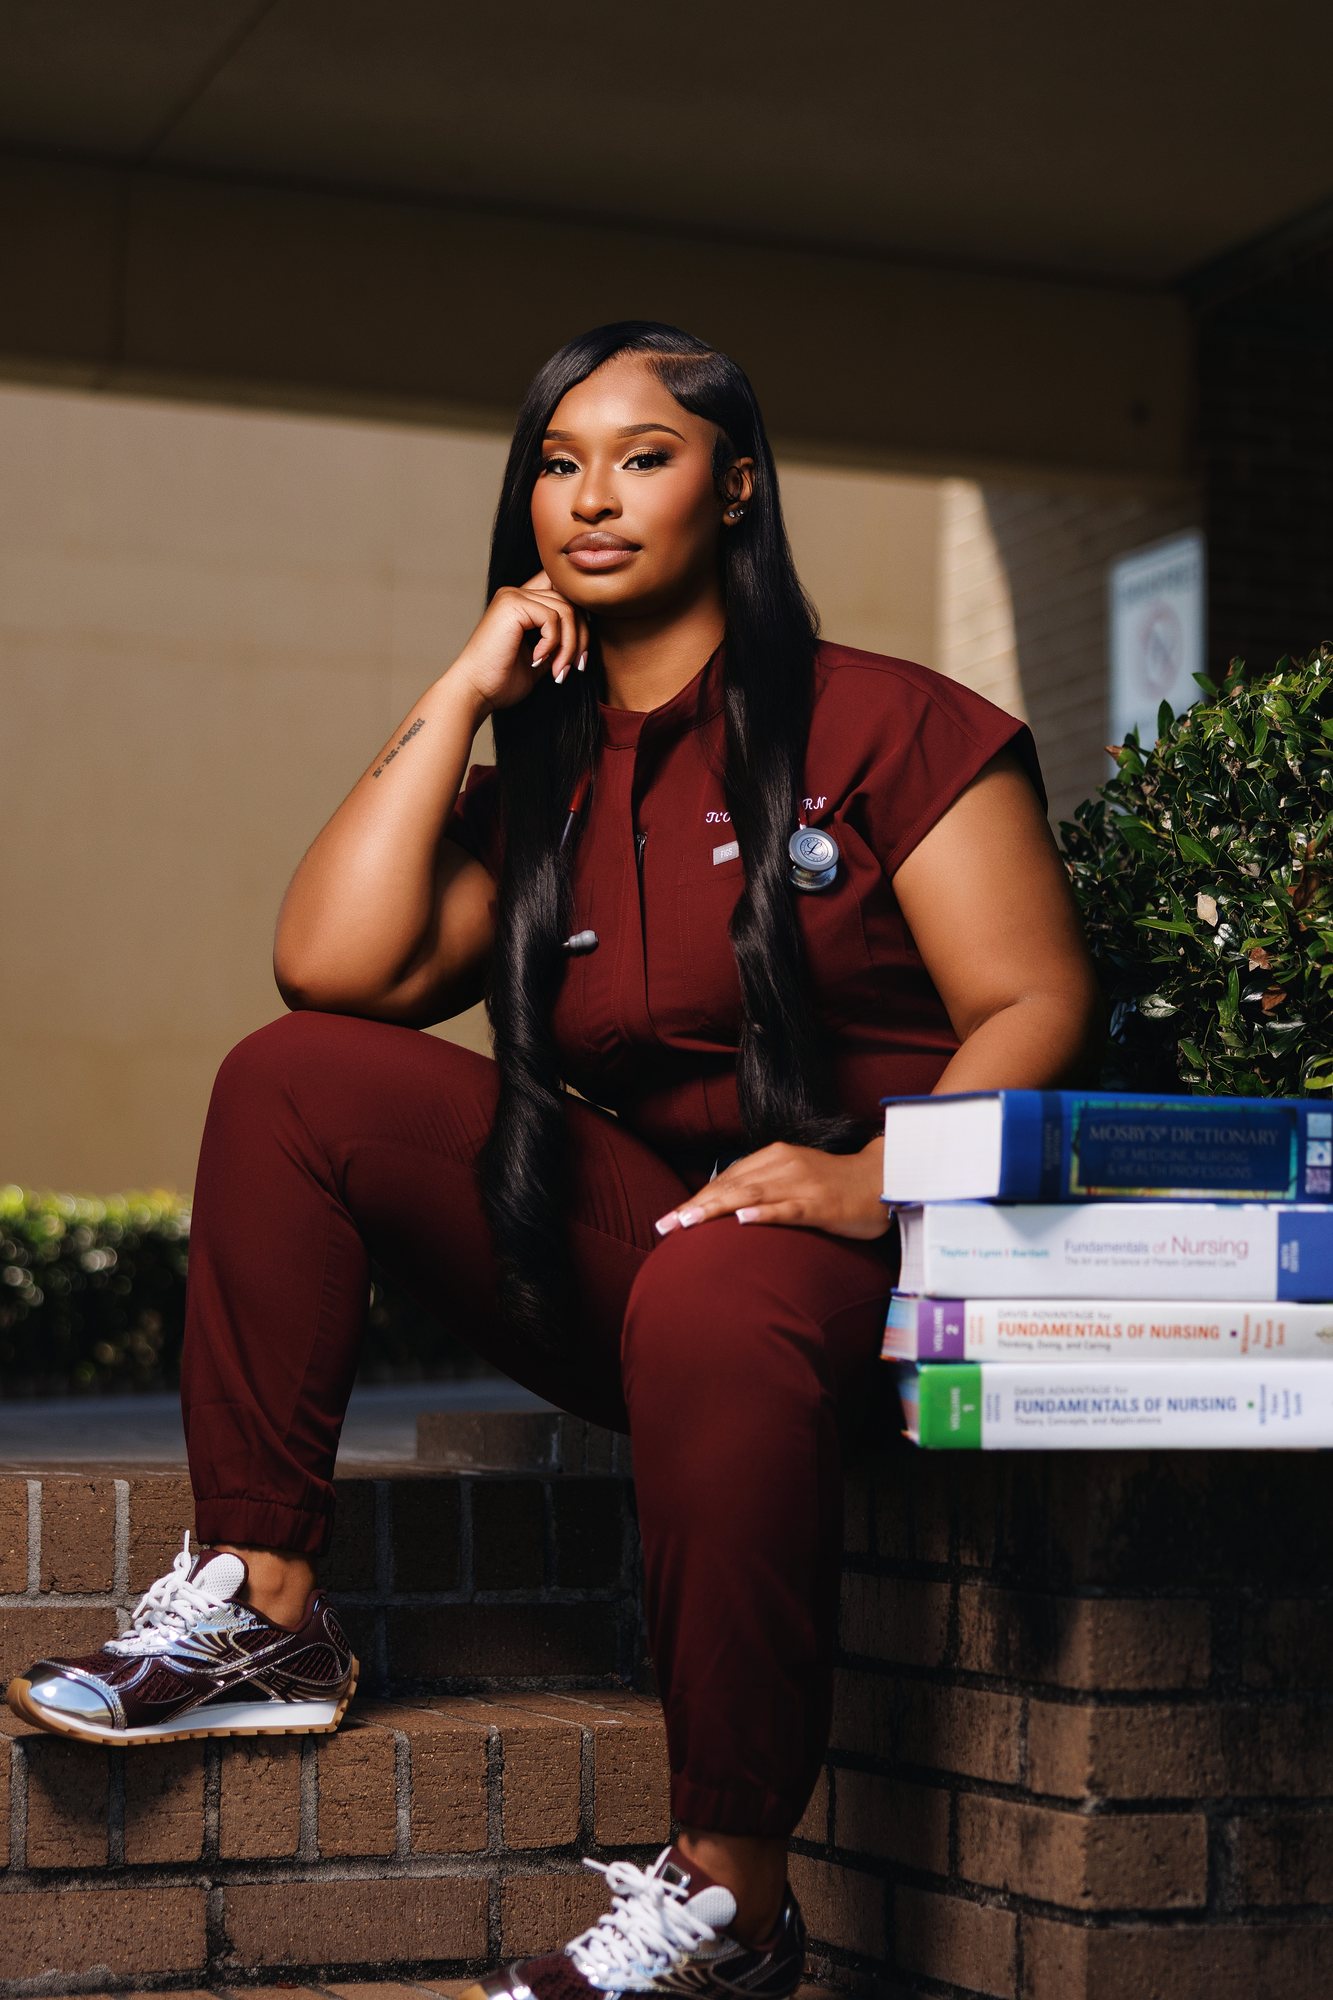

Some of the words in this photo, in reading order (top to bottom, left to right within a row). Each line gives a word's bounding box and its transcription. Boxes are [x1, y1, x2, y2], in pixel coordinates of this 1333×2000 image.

[802, 796, 827, 810] RN
[720, 847, 733, 859] FIGS
[1171, 1126, 1279, 1146] DICTIONARY
[1111, 1147, 1127, 1160] OF
[1195, 1148, 1249, 1164] NURSING
[1118, 1164, 1166, 1178] HEALTH
[1169, 1165, 1252, 1180] PROFESSIONS
[1064, 1239, 1149, 1254] Fundamentals
[1152, 1241, 1167, 1254] of
[1172, 1235, 1248, 1261] Nursing
[998, 1309, 1028, 1320] DAVIS
[1032, 1309, 1094, 1320] ADVANTAGE
[945, 1324, 959, 1336] 2
[998, 1322, 1121, 1338] FUNDAMENTALS
[1127, 1323, 1144, 1339] OF
[1150, 1323, 1220, 1340] NURSING
[1084, 1341, 1111, 1352] Caring
[962, 1404, 975, 1413] 1
[1014, 1398, 1138, 1414] FUNDAMENTALS
[1144, 1397, 1161, 1412] OF
[1167, 1396, 1238, 1413] NURSING
